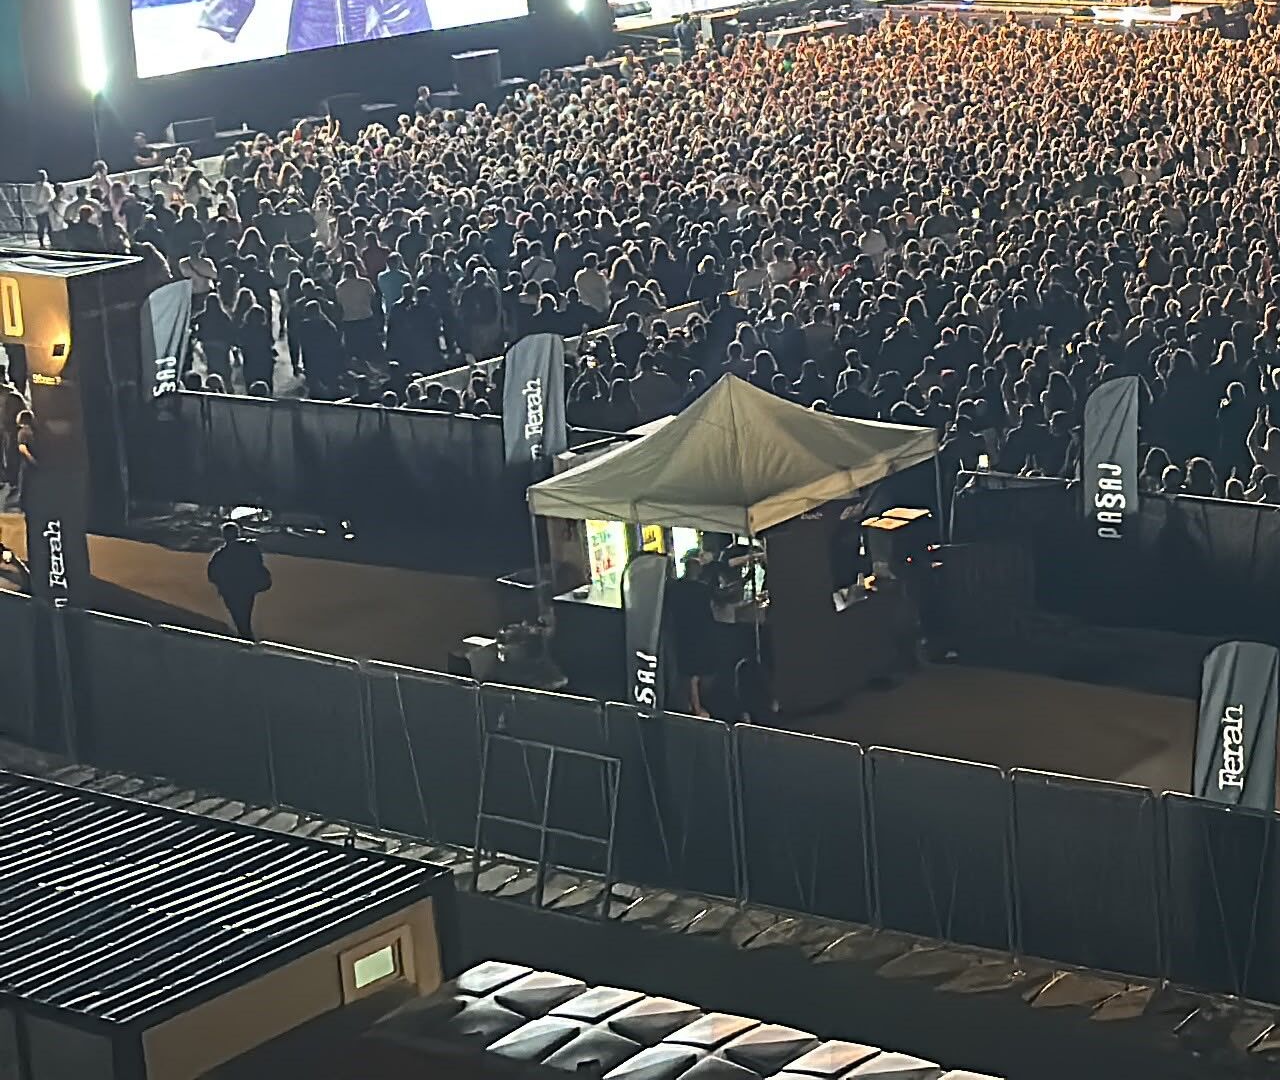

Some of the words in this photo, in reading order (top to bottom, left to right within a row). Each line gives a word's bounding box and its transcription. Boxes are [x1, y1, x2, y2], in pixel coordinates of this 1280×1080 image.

[522, 377, 544, 440] Ferah
[43, 520, 68, 589] Ferah
[1218, 704, 1245, 791] Ferah
